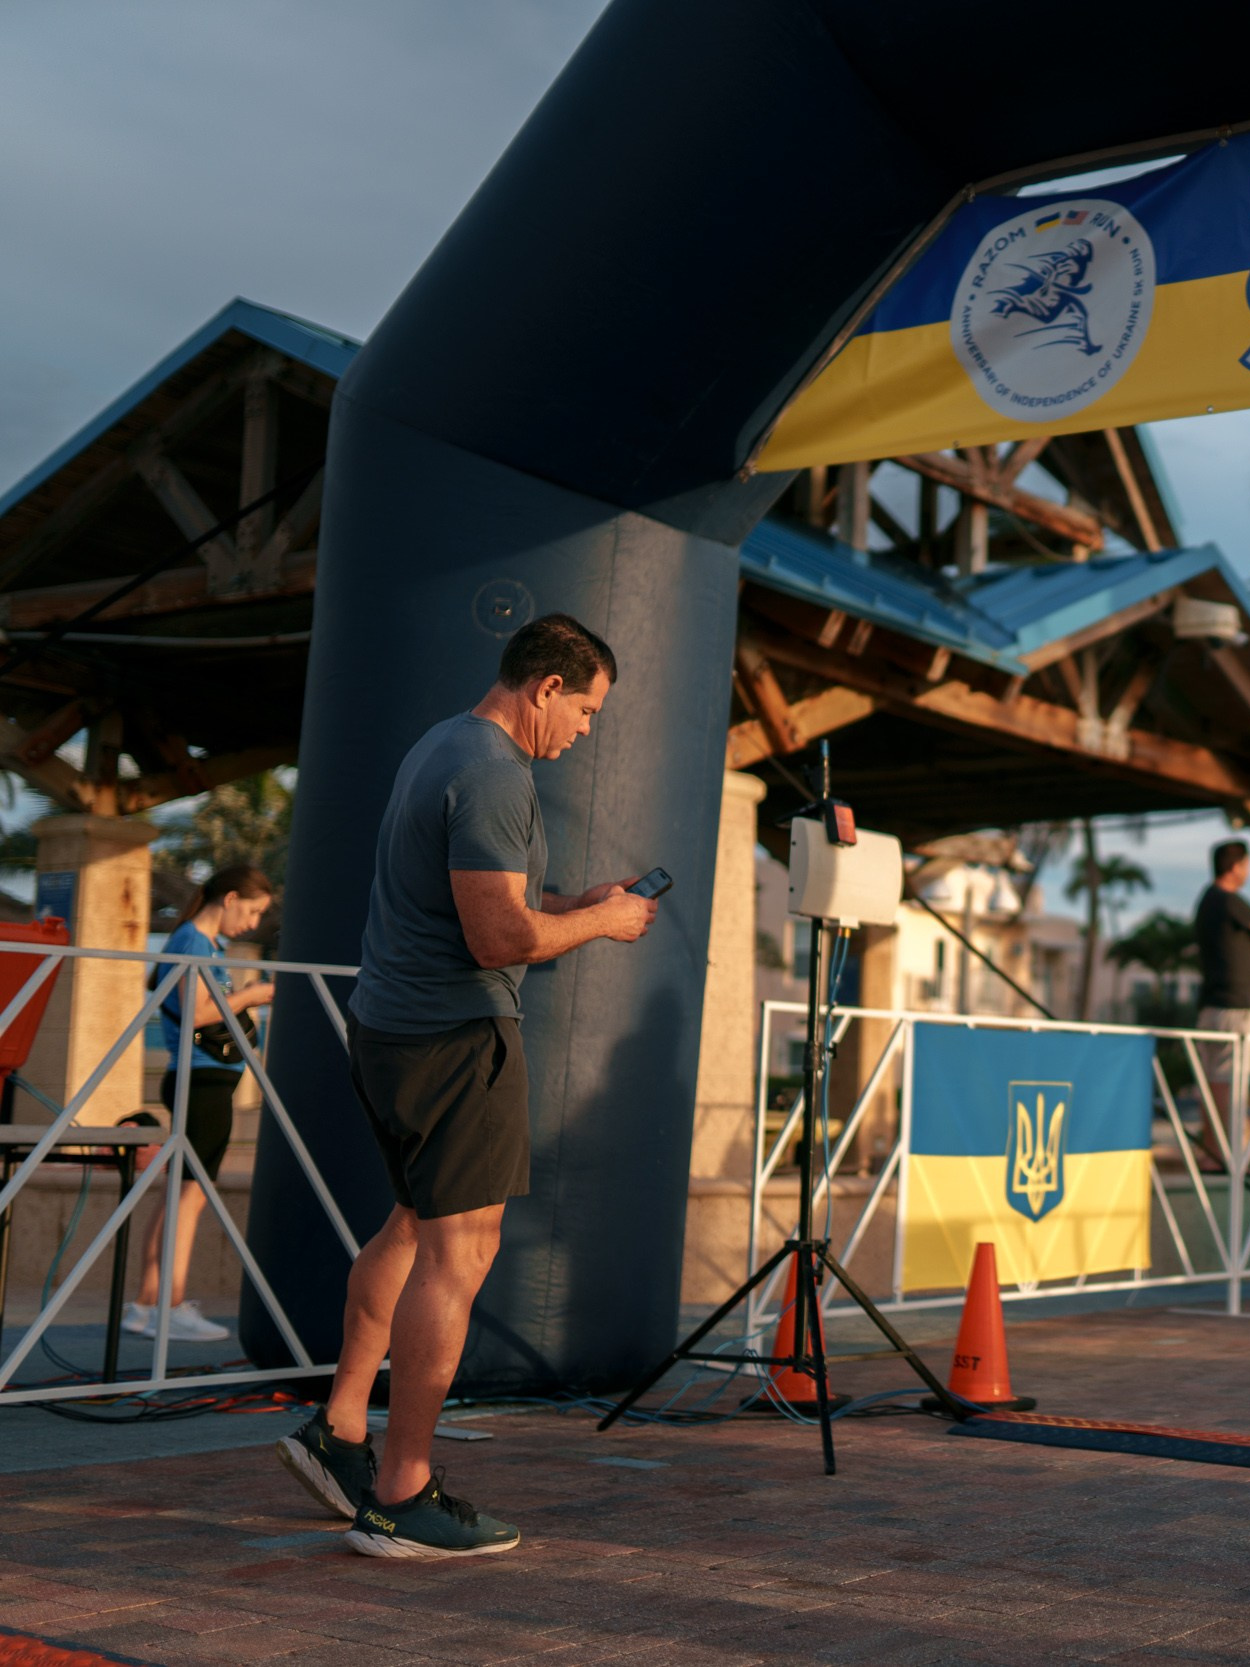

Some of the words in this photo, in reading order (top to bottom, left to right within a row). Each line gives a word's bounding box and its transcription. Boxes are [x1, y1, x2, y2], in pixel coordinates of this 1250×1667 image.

[972, 227, 1026, 288] RAZOM
[1090, 212, 1121, 239] RUN
[1010, 377, 1097, 407] INDEPENDENCE
[1097, 360, 1112, 378] OF
[1113, 301, 1141, 359] UKRAINE
[1130, 248, 1143, 276] RUN
[364, 1510, 396, 1533] HOKA
